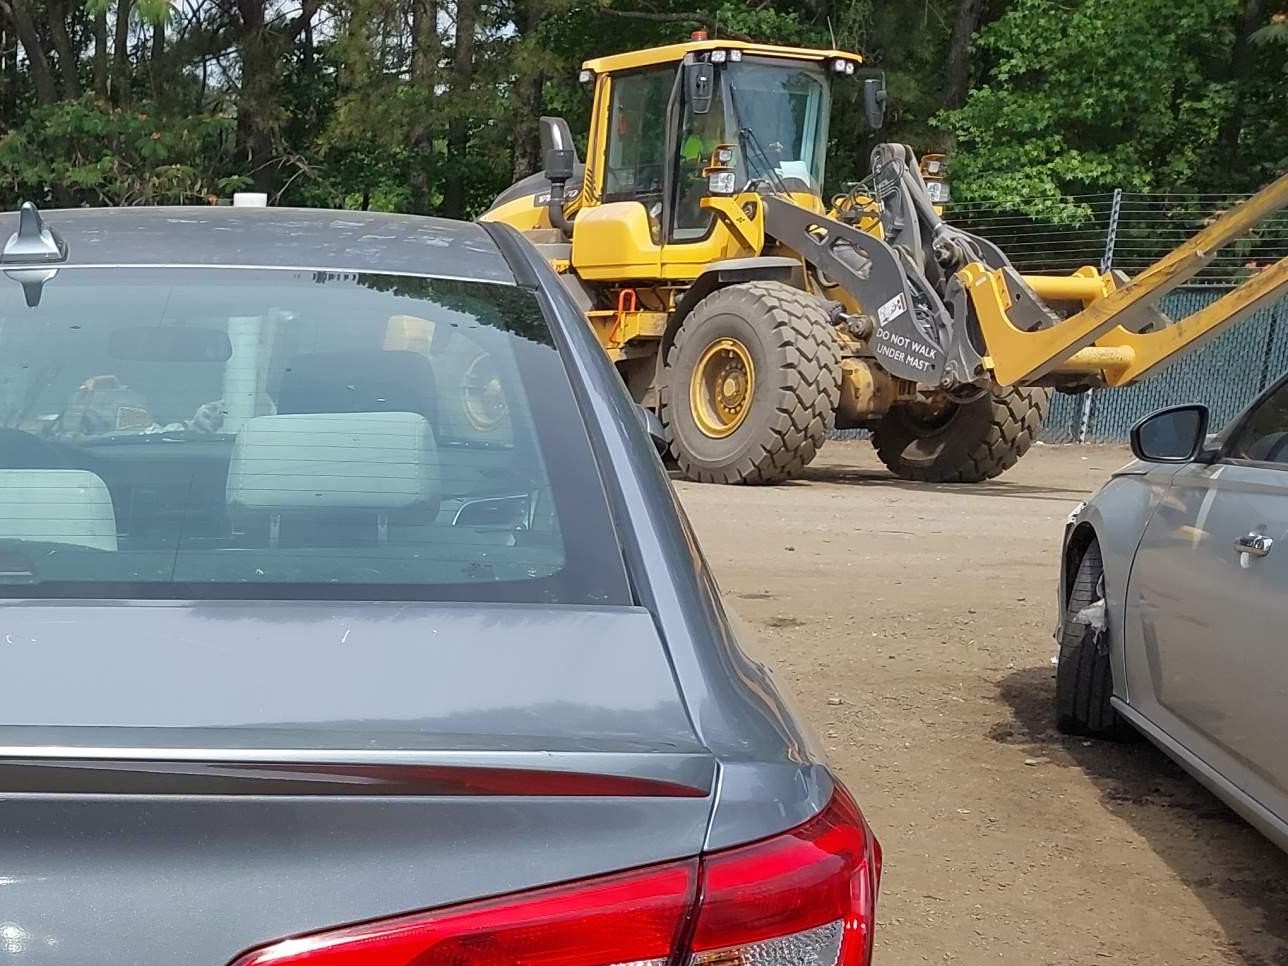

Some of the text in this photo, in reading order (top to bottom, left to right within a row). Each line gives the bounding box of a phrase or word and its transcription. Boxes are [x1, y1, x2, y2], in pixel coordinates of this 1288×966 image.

[876, 327, 937, 360] DO NOT WALK
[877, 343, 930, 372] UNDER MAST
